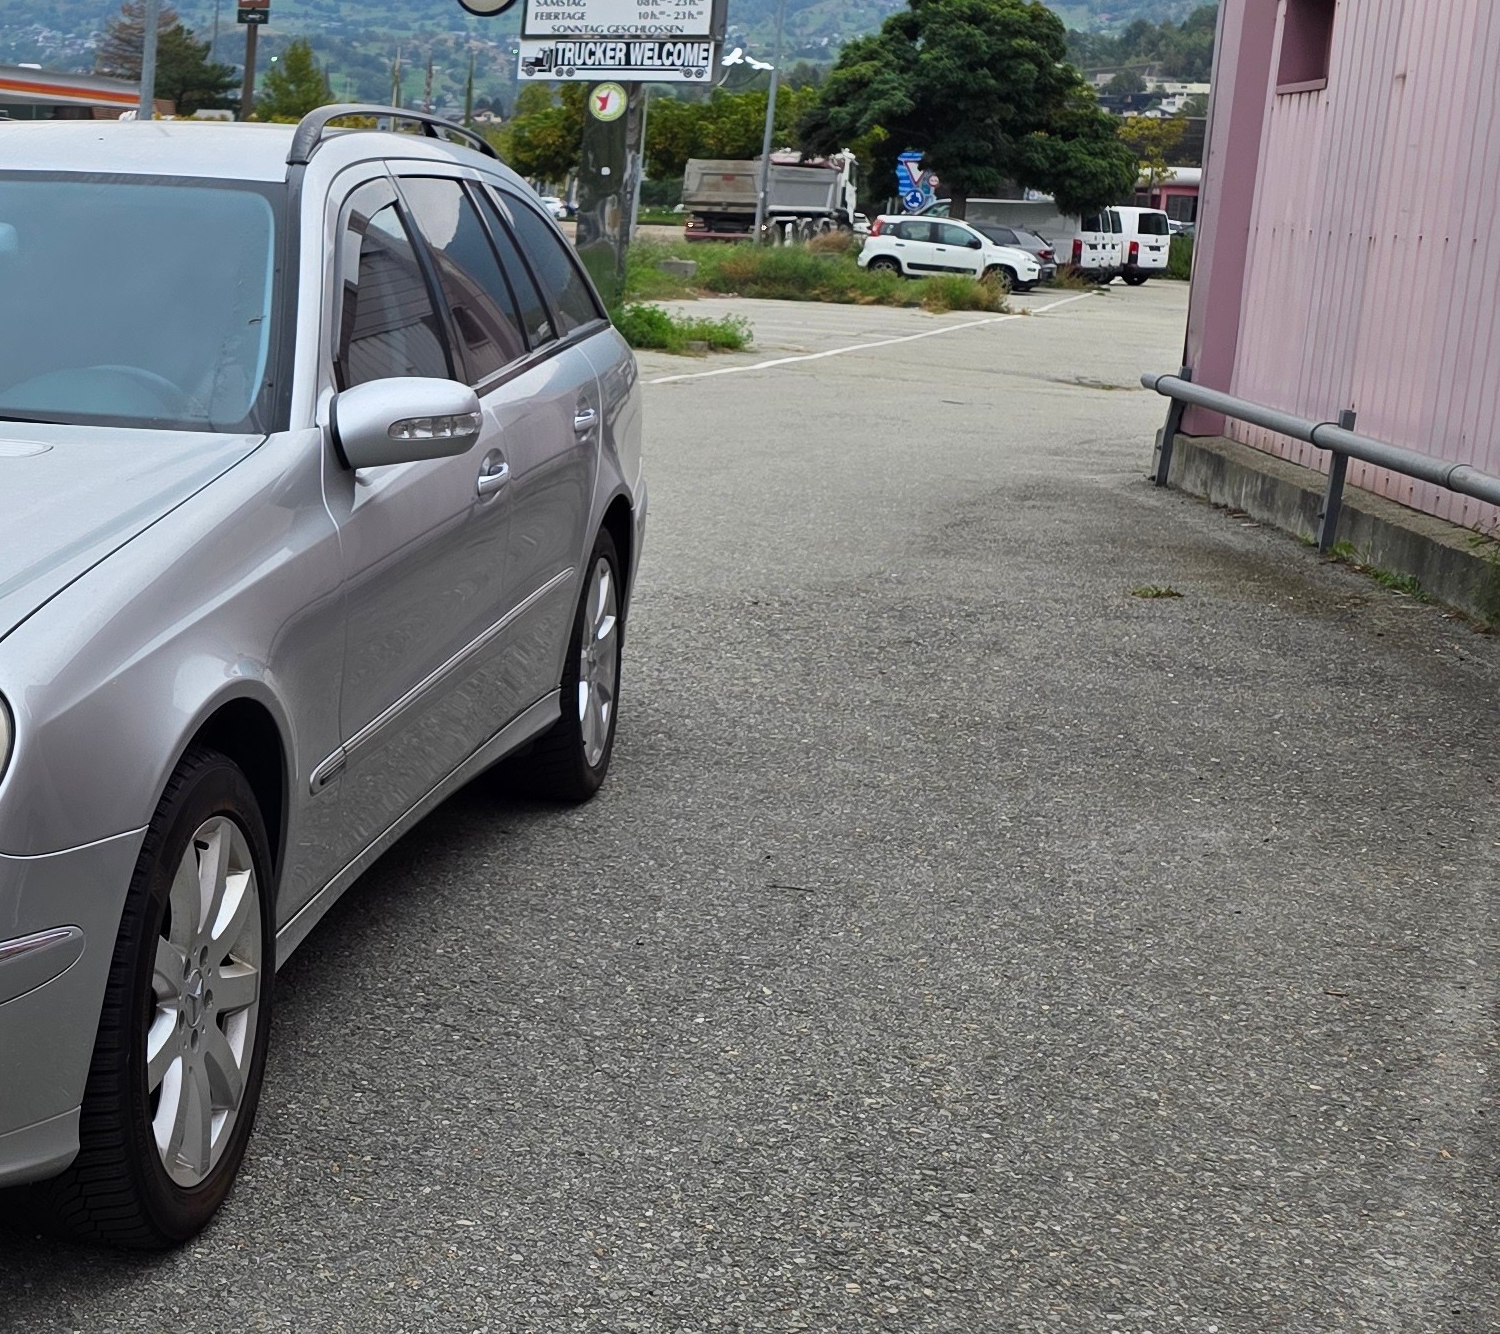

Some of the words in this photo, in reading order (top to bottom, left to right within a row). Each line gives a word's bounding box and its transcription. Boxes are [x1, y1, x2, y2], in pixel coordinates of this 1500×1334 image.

[534, 11, 587, 21] FEIERTAGE
[551, 24, 604, 33] SONNTAG
[606, 24, 685, 33] GESCHLOSSEN
[556, 42, 625, 65] TRUCKER
[630, 42, 709, 66] WELCOME
